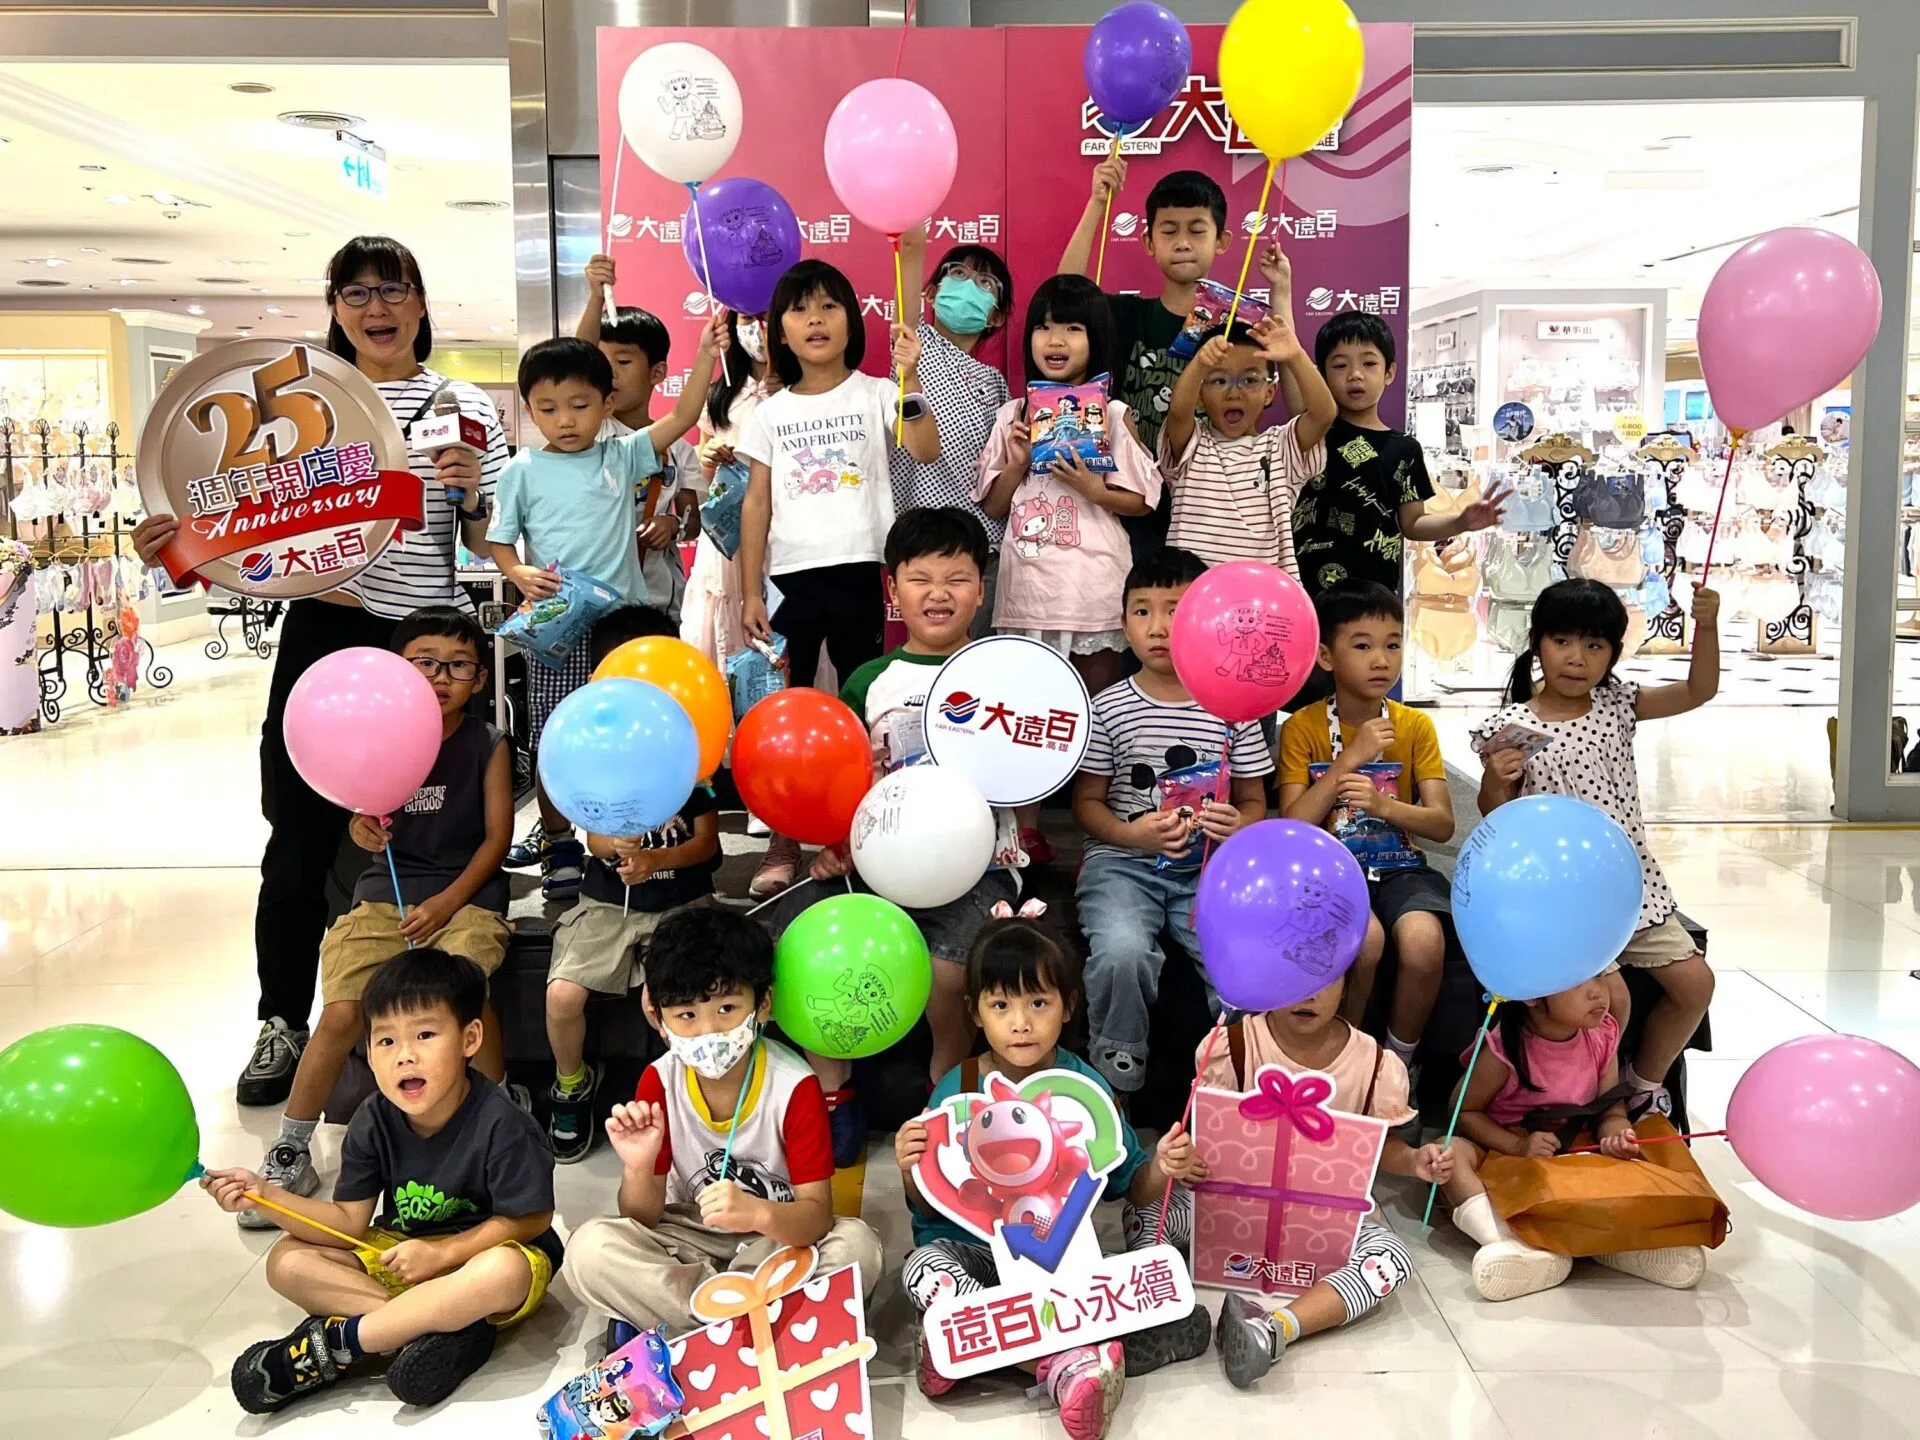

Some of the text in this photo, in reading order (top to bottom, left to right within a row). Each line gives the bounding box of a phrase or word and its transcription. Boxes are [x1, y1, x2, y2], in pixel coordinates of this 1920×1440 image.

[1084, 142, 1106, 151] FAR
[934, 214, 1000, 243] 大遠百
[1271, 209, 1338, 239] 大遠百
[1335, 286, 1401, 315] 大遠百
[184, 345, 337, 473] 25
[776, 413, 865, 437] HELLO KITTY
[781, 430, 866, 453] AND FRIENDS
[188, 443, 378, 518] 週年開店慶
[191, 483, 382, 541] Anniversary
[279, 528, 366, 576] 大遠百
[979, 702, 1079, 748] 大遠百
[1253, 1258, 1315, 1284] 大遠百
[940, 1258, 1182, 1365] 遠百心永續
